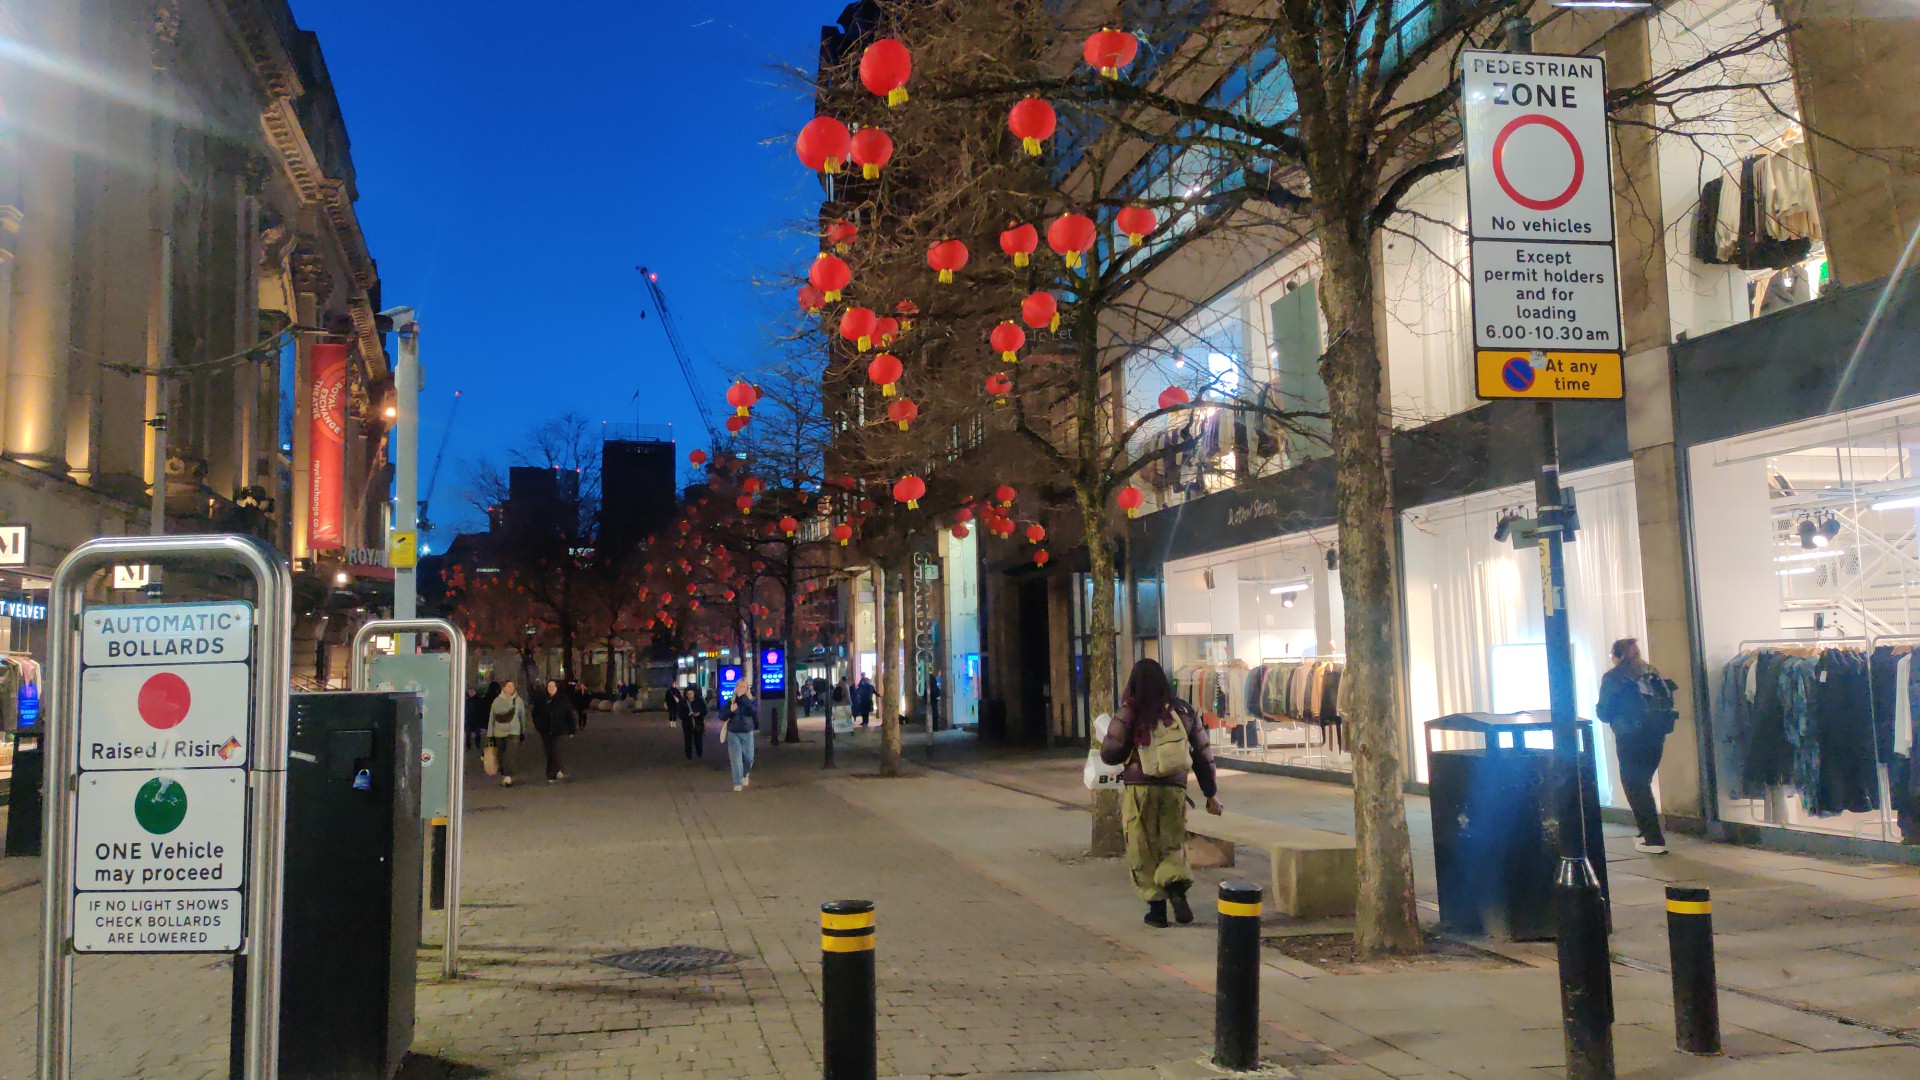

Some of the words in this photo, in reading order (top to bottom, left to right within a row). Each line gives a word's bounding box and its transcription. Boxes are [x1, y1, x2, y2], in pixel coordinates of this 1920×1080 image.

[1473, 58, 1593, 79] PEDESTRIAN
[1493, 82, 1577, 109] ZONE
[1492, 216, 1515, 231] No
[1522, 217, 1592, 233] vehicles
[1516, 249, 1572, 266] Except
[1484, 268, 1538, 283] permit
[1544, 269, 1605, 284] holders
[1516, 287, 1545, 300] and
[1551, 288, 1575, 301] for
[1516, 305, 1576, 322] loading
[1545, 359, 1563, 373] At
[1570, 361, 1597, 375] any
[1554, 377, 1591, 391] time
[312, 380, 324, 420] THEATRE
[327, 381, 343, 410] ROYAL
[319, 388, 342, 434] EXCHANGE
[10, 602, 45, 620] VELVET
[101, 613, 232, 634] AUTOMATIC
[108, 637, 224, 658] BOLLARDS
[91, 741, 157, 760] Raised
[174, 739, 226, 758] Risin
[95, 842, 142, 860] ONE
[150, 841, 224, 859] Vehicle
[95, 868, 135, 885] may
[142, 863, 223, 884] proceed
[89, 900, 101, 911] IF
[106, 900, 126, 912] NO
[131, 900, 172, 912] LIGHT
[176, 899, 229, 911] SHOWS
[95, 916, 143, 928] CHECK
[148, 915, 221, 927] BOLLARDS
[107, 932, 134, 944] ARE
[139, 932, 208, 944] LOWERED
